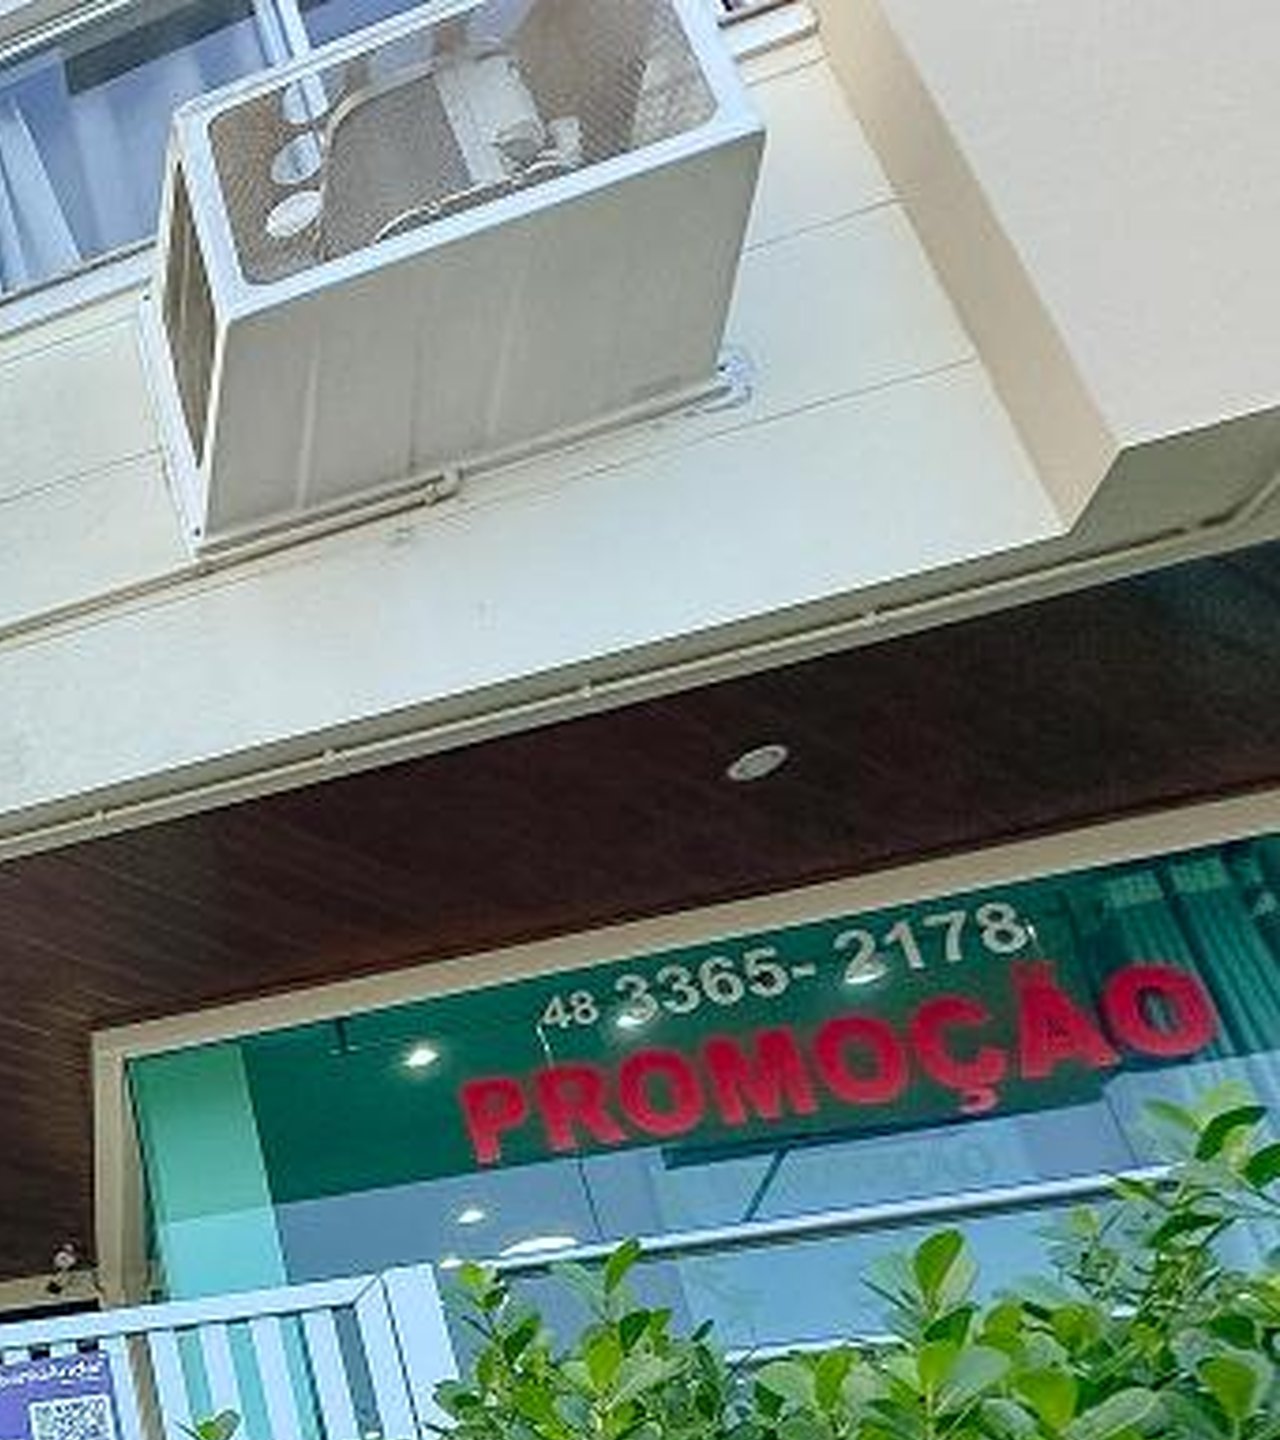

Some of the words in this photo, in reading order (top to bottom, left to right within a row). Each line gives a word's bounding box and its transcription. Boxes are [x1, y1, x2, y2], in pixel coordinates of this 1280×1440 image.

[542, 992, 600, 1029] 48
[834, 902, 1027, 984] 2178
[460, 958, 1217, 1164] PROMOÇÃO
